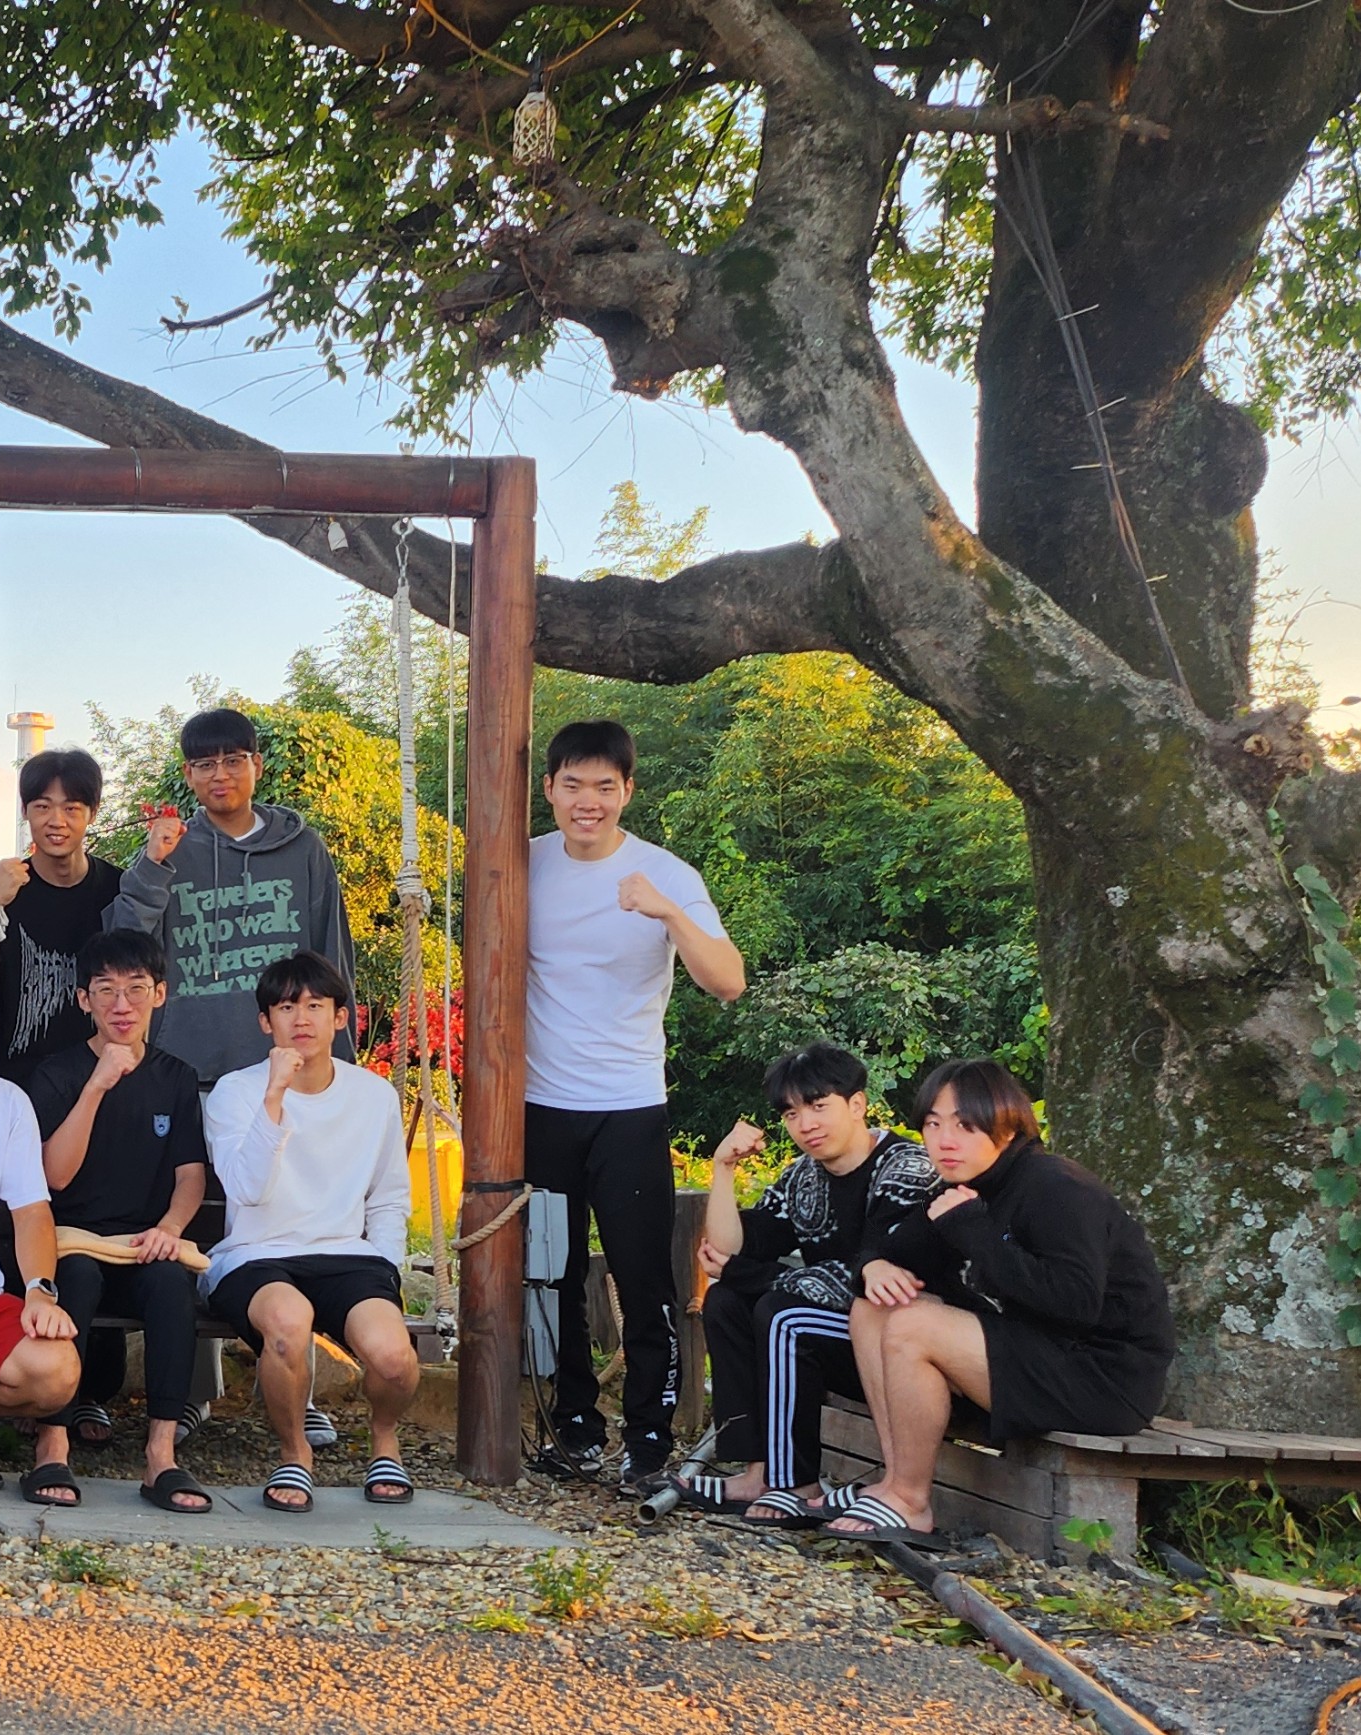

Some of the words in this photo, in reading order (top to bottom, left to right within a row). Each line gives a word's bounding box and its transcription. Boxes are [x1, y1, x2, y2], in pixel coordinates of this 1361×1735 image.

[171, 872, 293, 915] Travelers
[172, 911, 234, 948] who
[235, 900, 301, 937] walk
